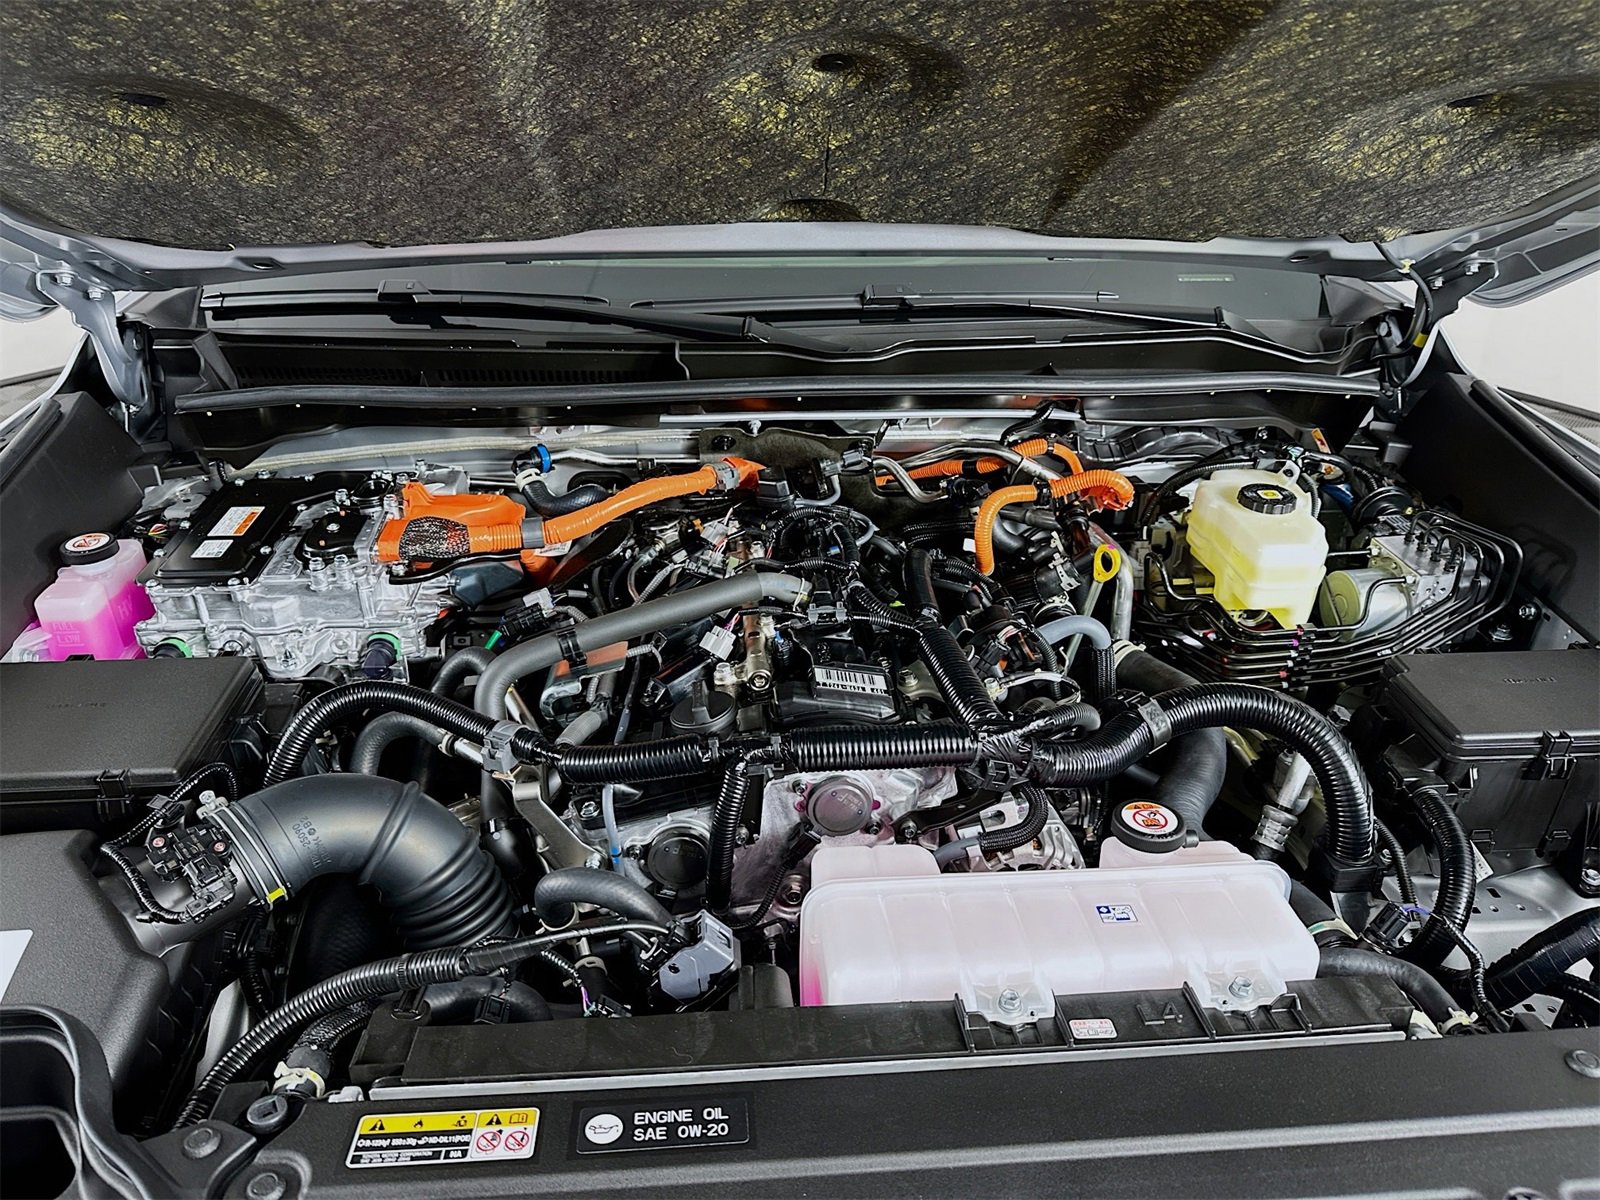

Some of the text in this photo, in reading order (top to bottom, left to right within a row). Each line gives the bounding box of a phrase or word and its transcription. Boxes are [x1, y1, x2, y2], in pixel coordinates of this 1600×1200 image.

[52, 622, 77, 631] FULL
[633, 1107, 729, 1125] ENGINE OIL
[633, 1122, 729, 1141] SAE 0W-20
